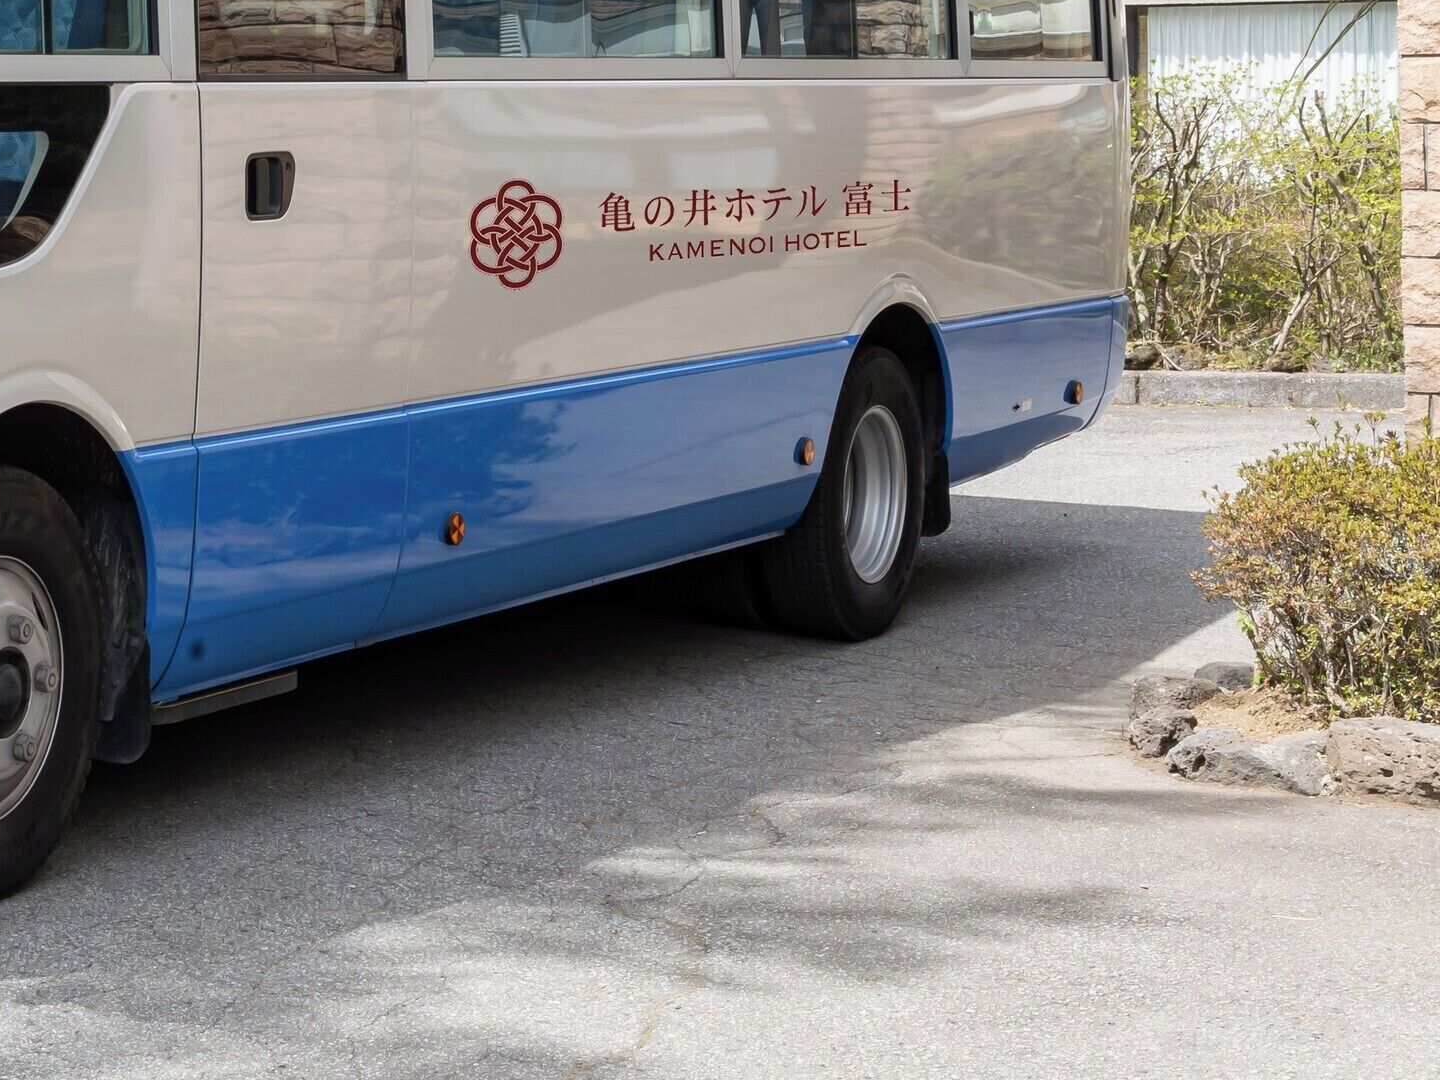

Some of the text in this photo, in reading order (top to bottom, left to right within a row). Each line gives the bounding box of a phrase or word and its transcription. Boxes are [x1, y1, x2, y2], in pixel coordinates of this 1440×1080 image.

[598, 178, 912, 232] 亀の井ホテル 富士
[648, 229, 868, 262] KAMENOI HOTEL
